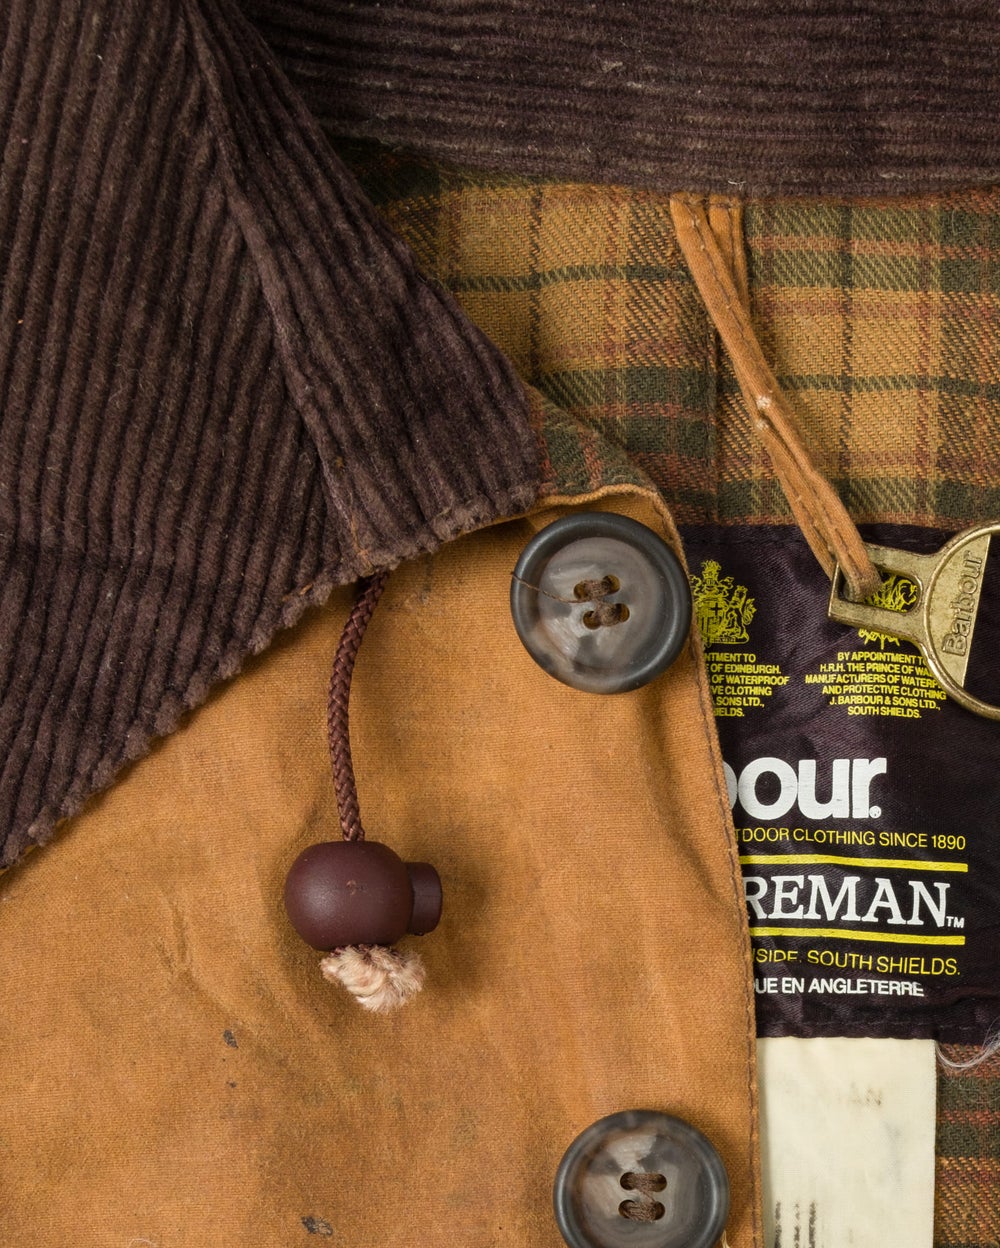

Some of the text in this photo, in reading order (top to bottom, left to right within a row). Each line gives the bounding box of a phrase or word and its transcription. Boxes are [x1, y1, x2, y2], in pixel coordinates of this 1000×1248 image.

[942, 549, 982, 656] Barbour
[743, 653, 756, 663] TO
[837, 652, 850, 661] BY
[851, 652, 916, 664] APPOINTMENT
[710, 663, 724, 672] OF
[725, 664, 781, 674] EDINBURGH.
[820, 663, 846, 672] H.R.H.
[847, 663, 865, 672] THE
[866, 663, 900, 673] PRINCE
[901, 665, 914, 674] OF
[711, 675, 725, 684] OF
[726, 675, 790, 685] WATERPROOF
[805, 674, 886, 684] MANUFACTURERS
[887, 674, 900, 684] OF
[725, 686, 772, 696] CLOTHING
[822, 685, 947, 700] AND PROTECTIVE CLOTHING
[716, 697, 742, 706] SONS
[829, 695, 941, 710] J. BARBOUR & SONS LTD.,
[847, 706, 922, 718] SOUTH SHIELDS.
[792, 829, 875, 845] CLOTHING
[879, 832, 928, 848] SINCE
[931, 835, 966, 850] 1890
[807, 950, 872, 970] SOUTH
[876, 956, 961, 975] SHIELDS.
[781, 977, 805, 993] EN
[808, 978, 924, 997] ANGLETERRE
